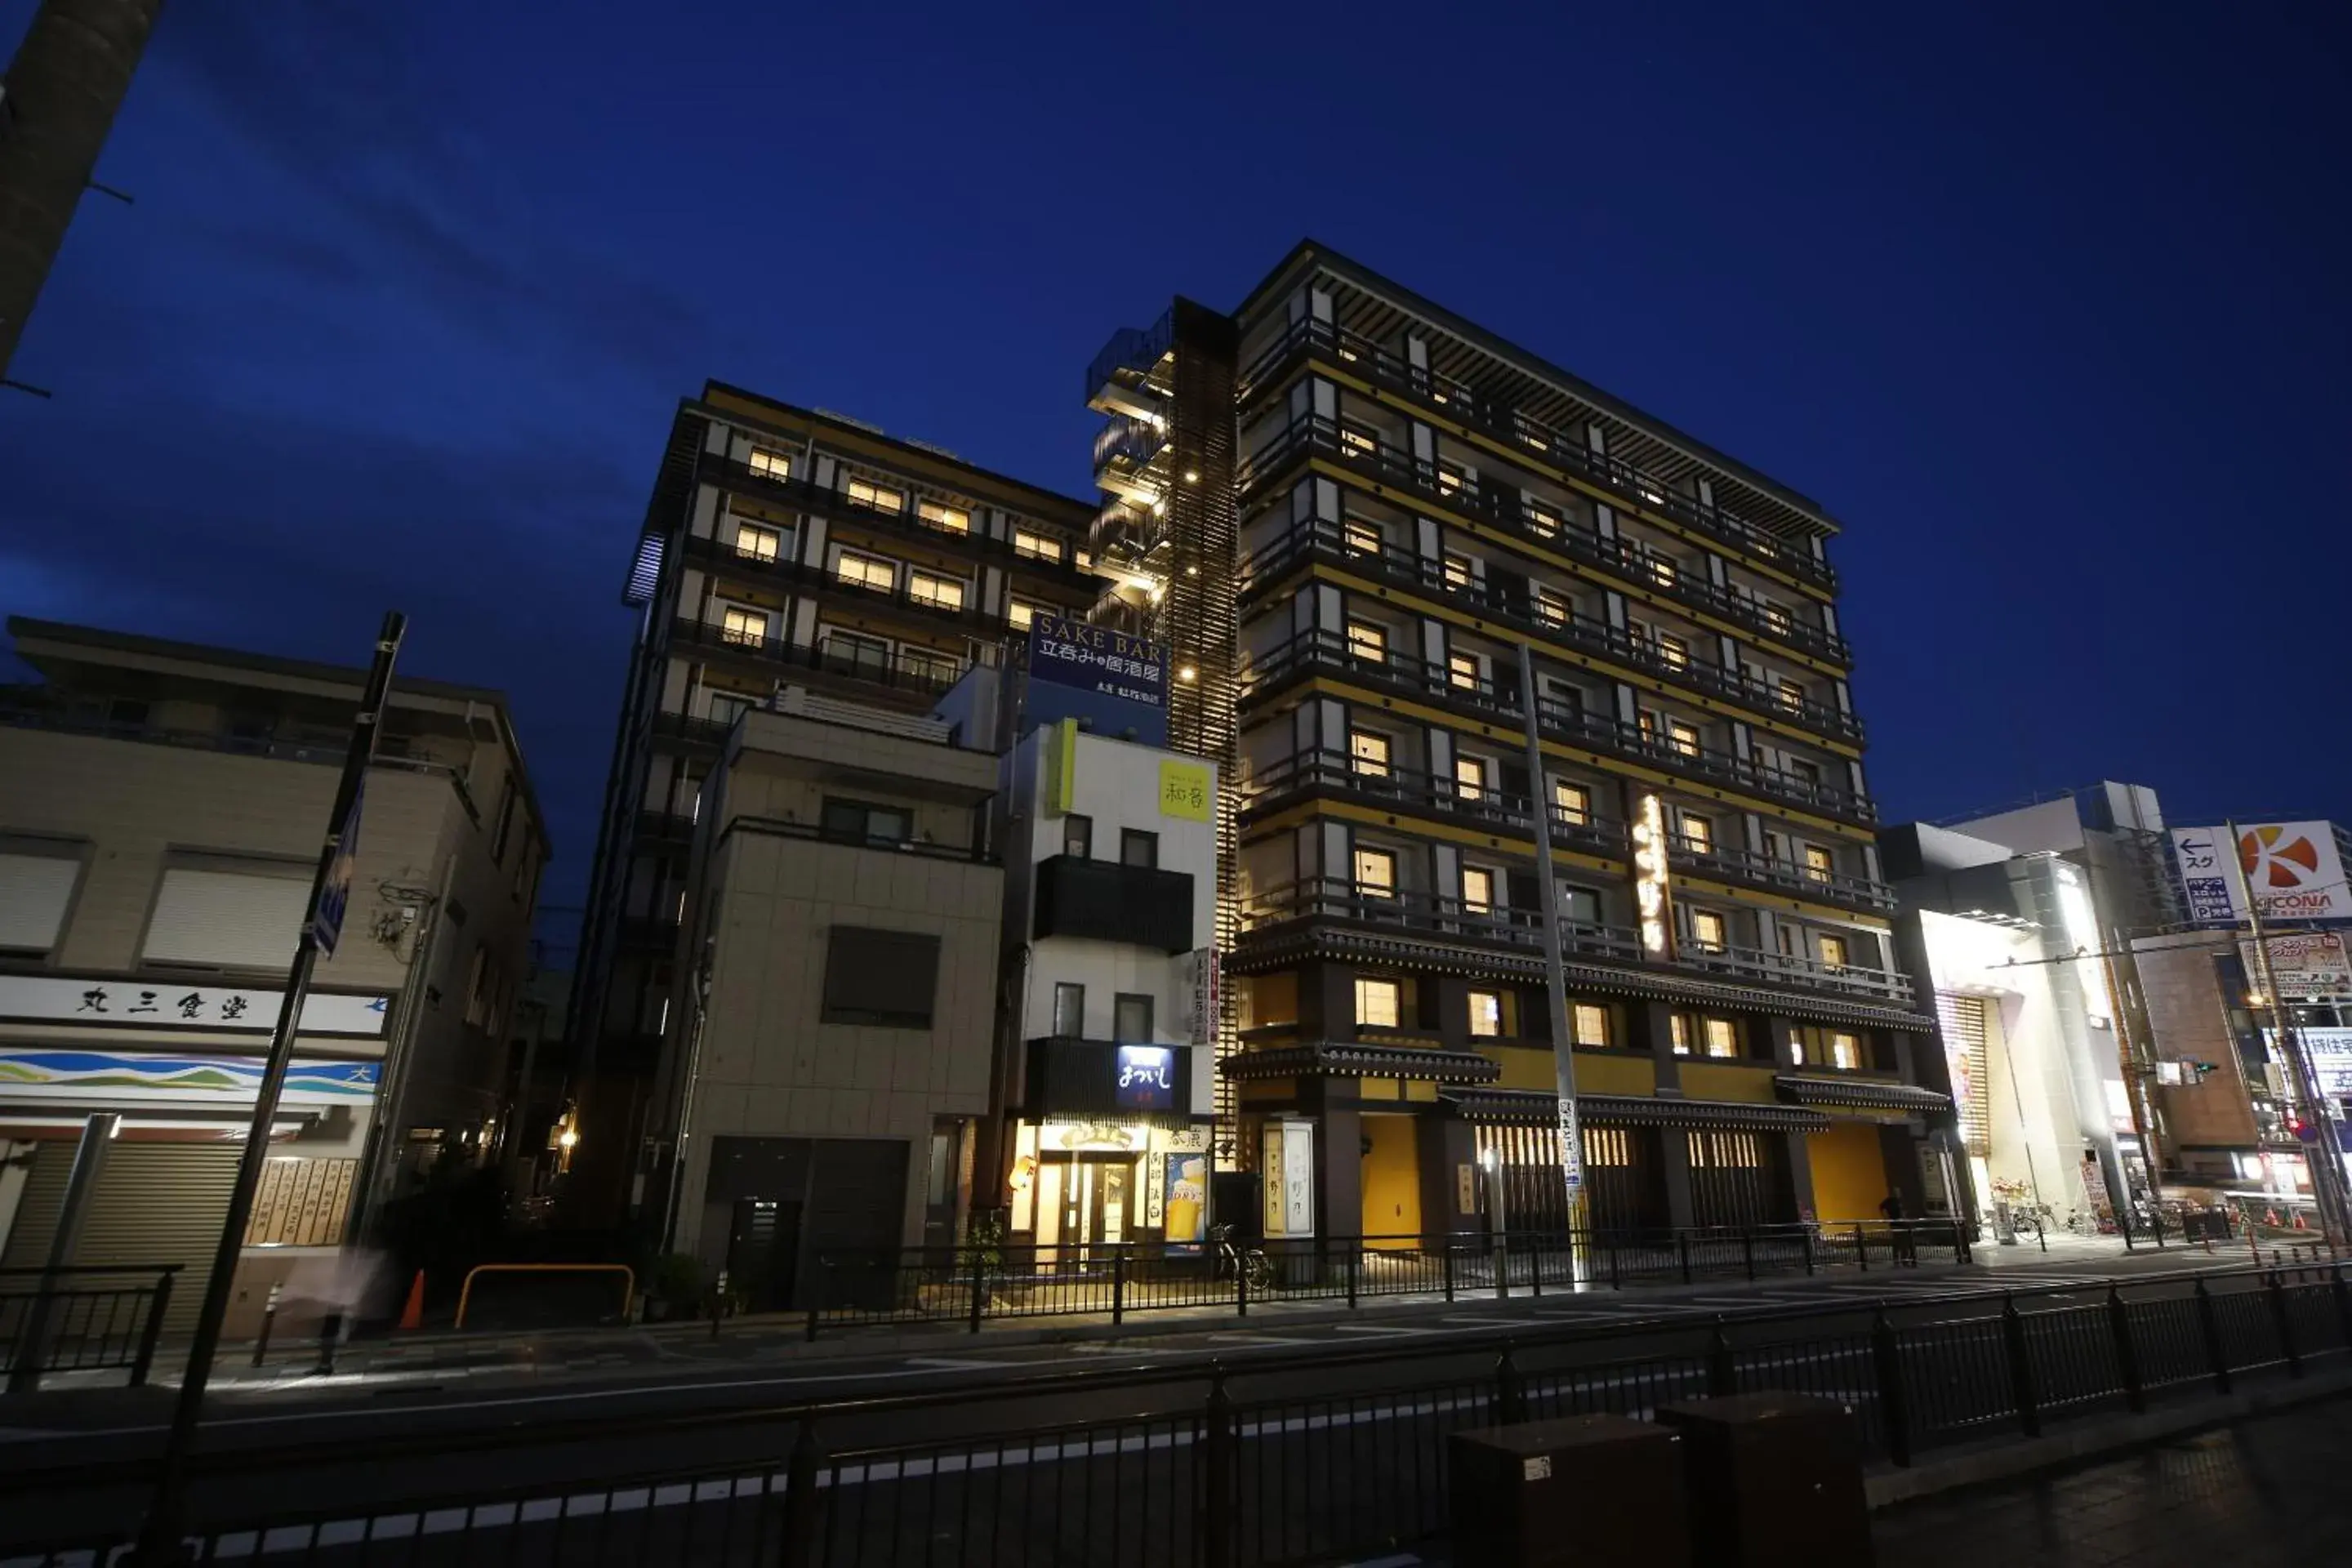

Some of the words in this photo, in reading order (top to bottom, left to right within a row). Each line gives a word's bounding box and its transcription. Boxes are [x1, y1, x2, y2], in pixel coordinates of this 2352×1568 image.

[1040, 617, 1105, 648] SAKE
[1116, 637, 1160, 663] BAR
[2186, 857, 2214, 869] スグ
[76, 987, 247, 1020] 丸三食堂
